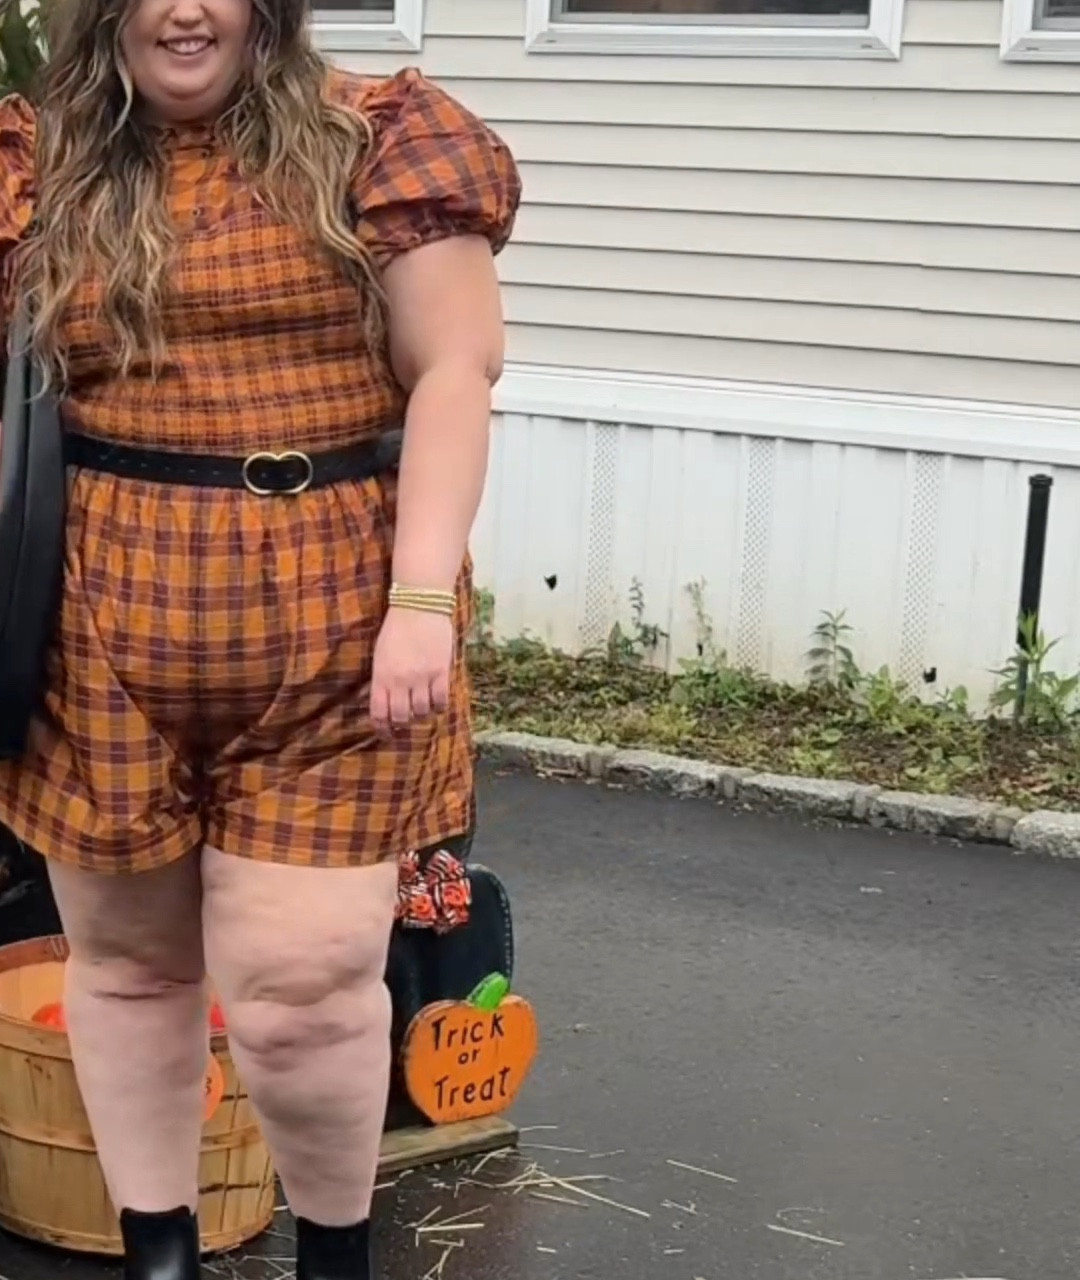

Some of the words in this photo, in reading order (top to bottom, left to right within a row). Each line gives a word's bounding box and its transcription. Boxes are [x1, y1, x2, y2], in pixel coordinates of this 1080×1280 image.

[431, 1012, 505, 1051] Trick
[458, 1048, 481, 1065] or
[434, 1067, 510, 1109] Treat
